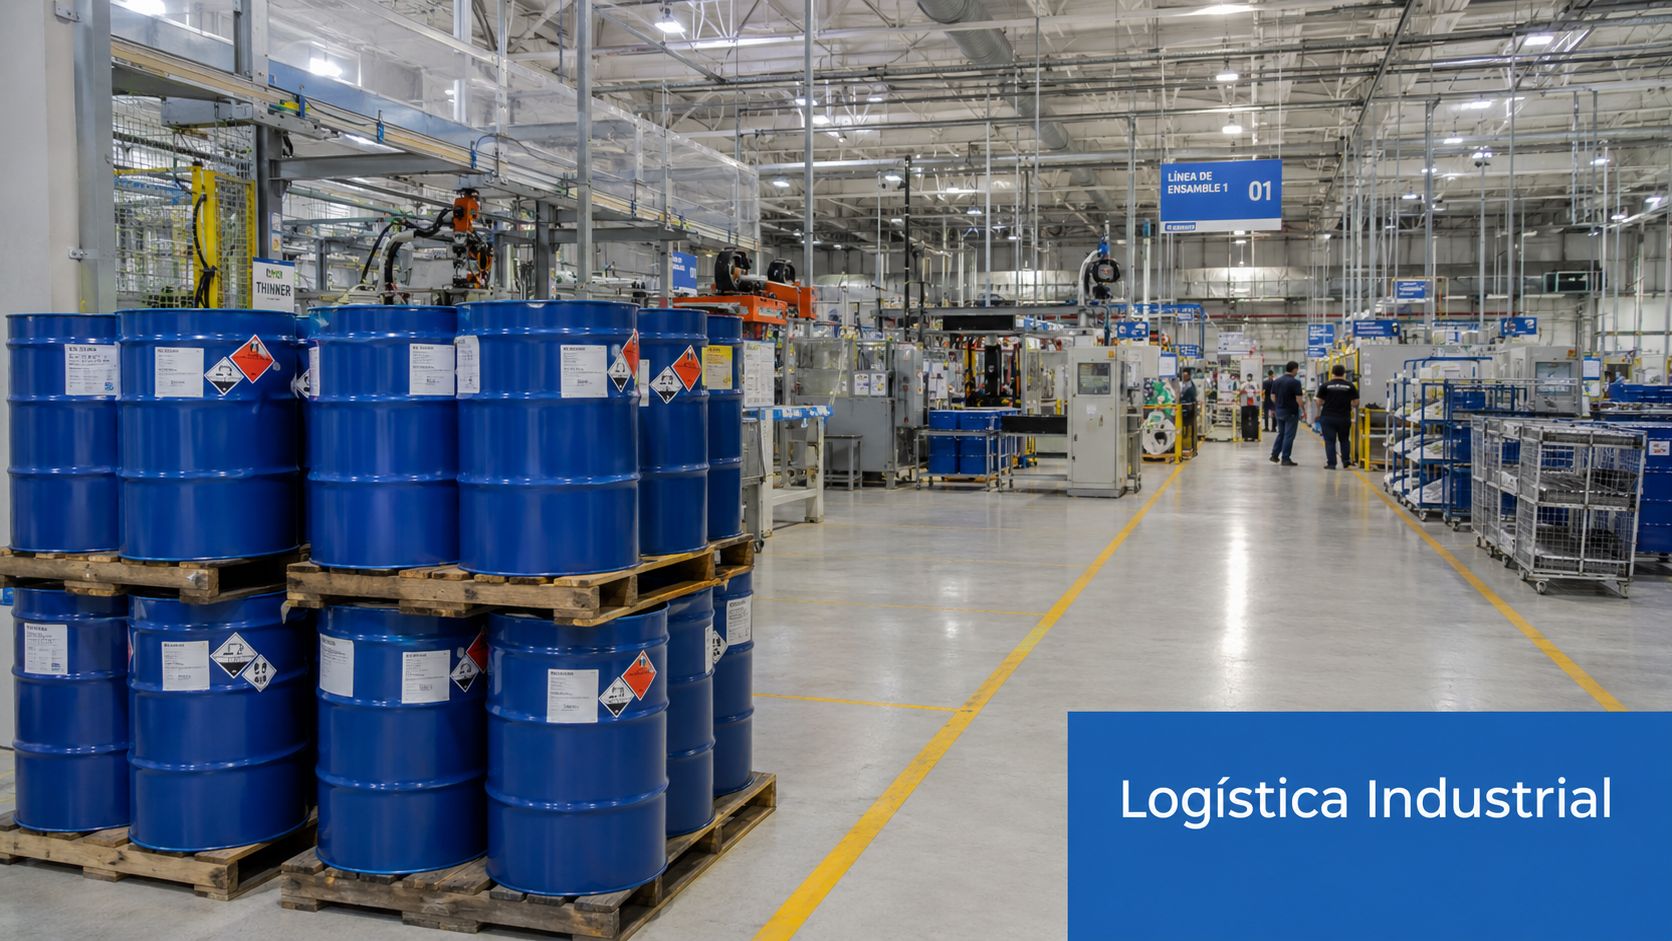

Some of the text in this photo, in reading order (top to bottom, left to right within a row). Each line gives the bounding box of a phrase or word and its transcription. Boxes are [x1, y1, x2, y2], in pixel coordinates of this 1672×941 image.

[1168, 170, 1212, 181] LÍNEA DE
[1168, 183, 1229, 194] ENSAMBLE 1
[1248, 180, 1272, 201] 01
[256, 281, 291, 297] THINNER
